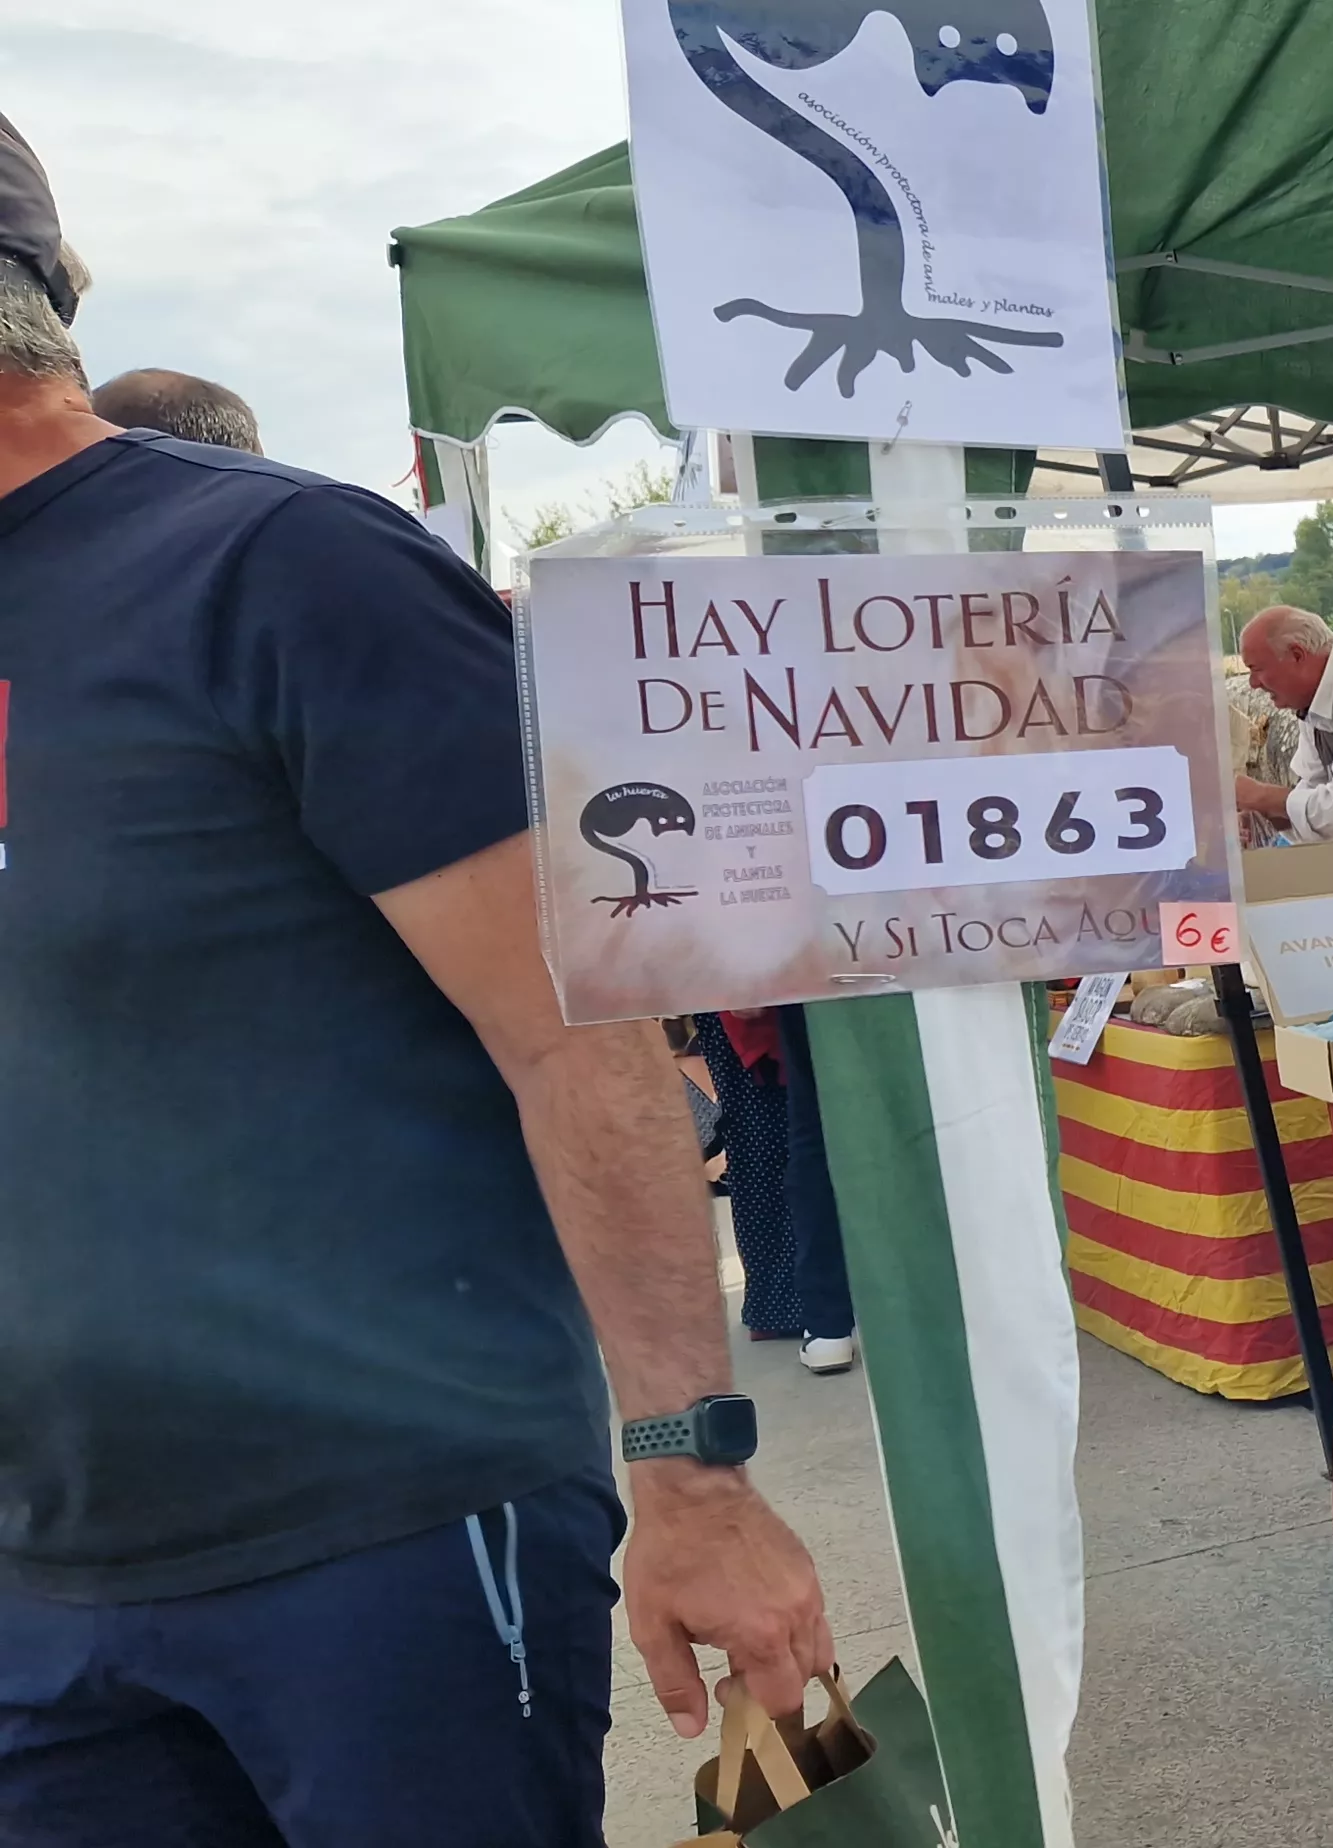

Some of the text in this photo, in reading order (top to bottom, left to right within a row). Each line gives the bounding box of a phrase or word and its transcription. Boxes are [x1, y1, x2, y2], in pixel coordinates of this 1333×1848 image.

[798, 91, 881, 158] asociación
[876, 153, 930, 237] protectora
[921, 238, 936, 262] de
[980, 297, 991, 312] y
[993, 298, 1055, 318] plantas
[628, 580, 789, 660] HAY
[635, 666, 1134, 753] DE NAVIDAD
[702, 776, 788, 796] ASOCIACIÓN
[702, 798, 793, 818] PROTECTORA
[704, 820, 794, 841] DE ANIMALES
[823, 786, 1169, 871] 01863
[745, 846, 757, 859] Y
[723, 864, 784, 884] PLANTAS
[719, 886, 793, 906] LA HUERTA
[833, 920, 865, 963] Y
[932, 909, 1056, 954] TOCA
[1075, 901, 1160, 943] AQU
